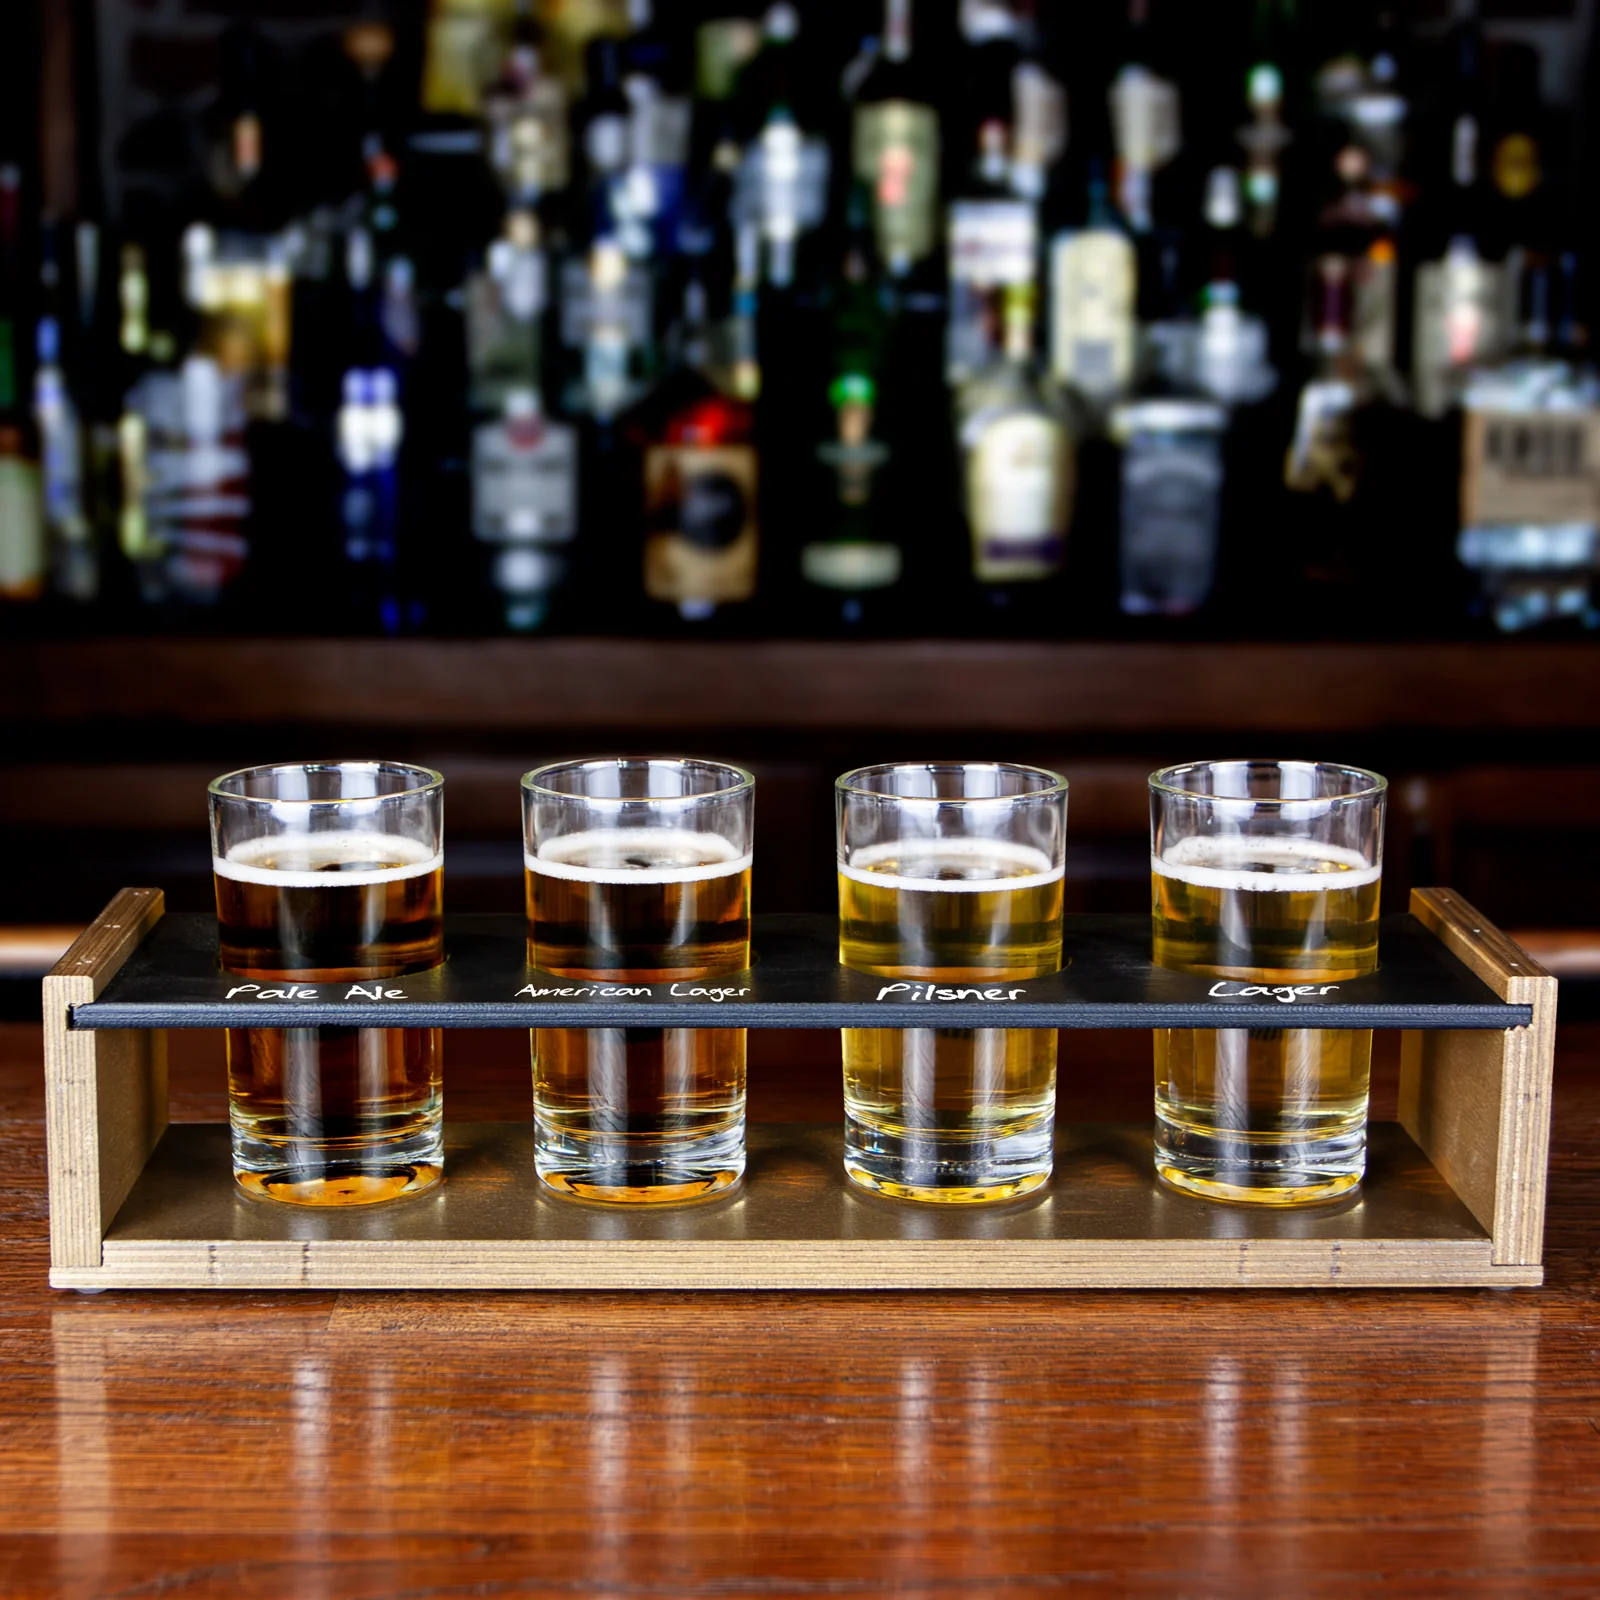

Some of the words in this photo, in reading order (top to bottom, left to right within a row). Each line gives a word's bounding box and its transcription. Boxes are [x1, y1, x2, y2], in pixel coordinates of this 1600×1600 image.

[225, 984, 320, 1000] Pale
[345, 984, 408, 1000] Ale
[515, 983, 652, 997] American
[669, 983, 751, 1002] Lager
[876, 983, 1026, 1001] Pilsner
[1208, 981, 1340, 1003] Lager
